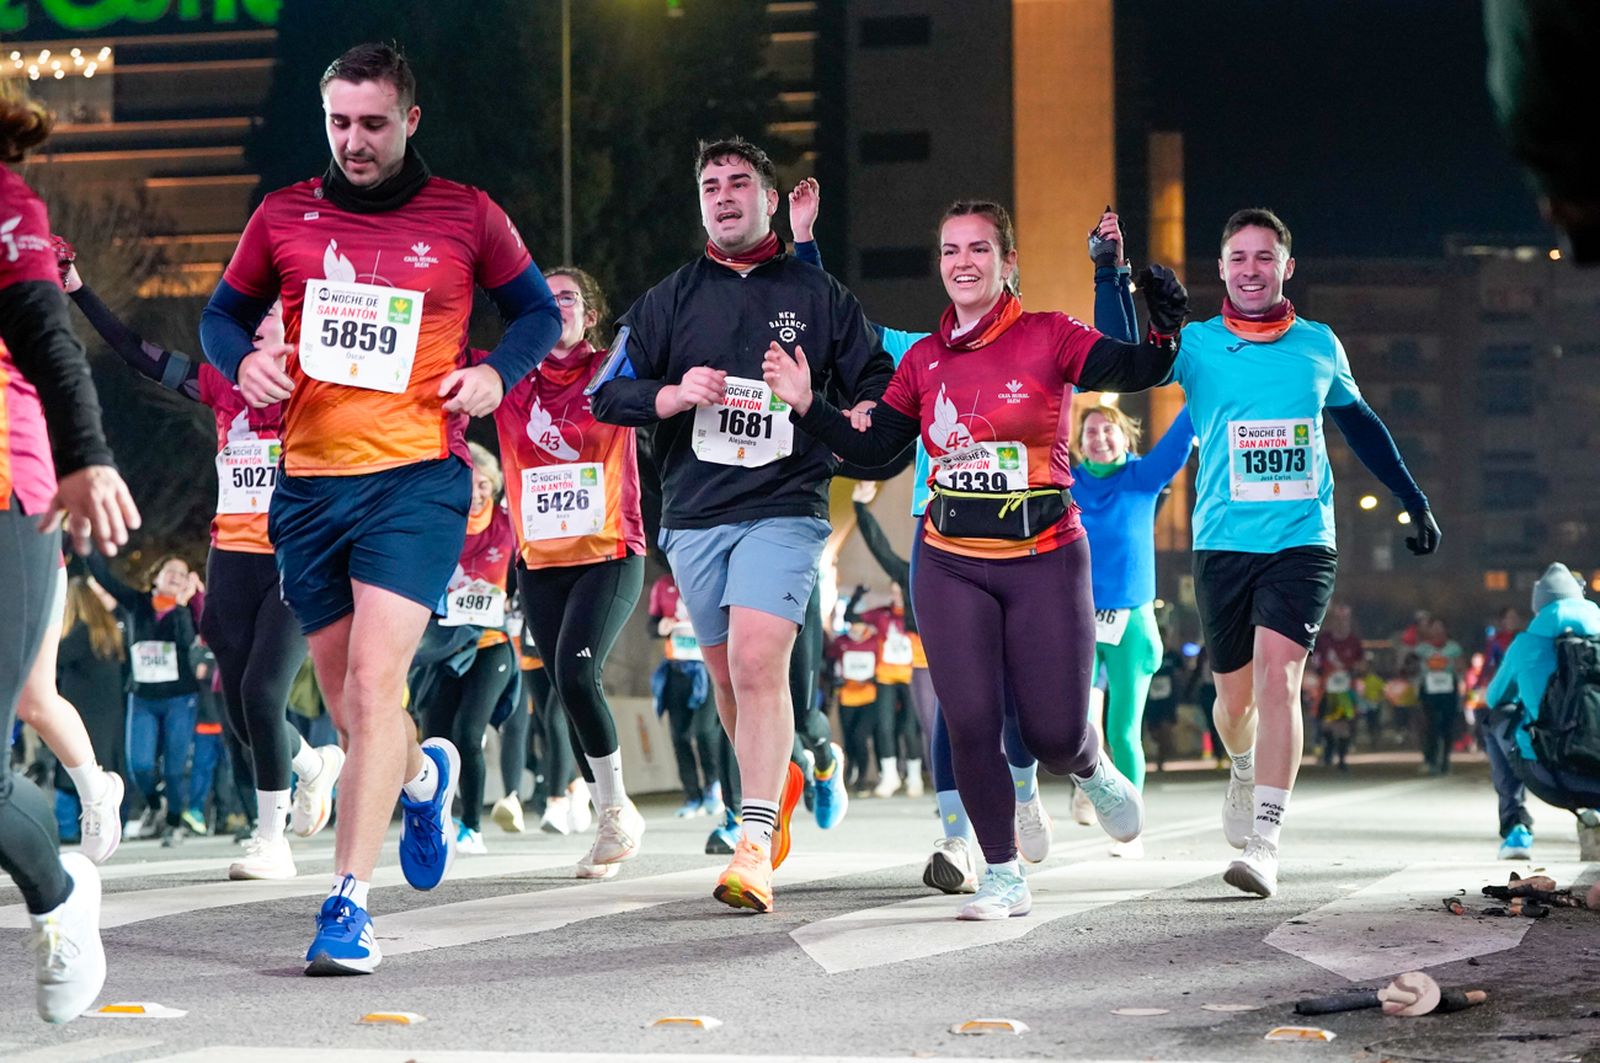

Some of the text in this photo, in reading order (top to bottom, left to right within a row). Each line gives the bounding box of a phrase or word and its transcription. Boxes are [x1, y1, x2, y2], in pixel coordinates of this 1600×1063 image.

[331, 294, 363, 306] NOCHE
[366, 297, 379, 308] DE
[317, 305, 339, 317] SAN
[778, 311, 796, 319] NEW
[769, 319, 807, 331] BALANCE
[321, 318, 397, 355] 5859
[751, 390, 764, 400] DE
[718, 408, 773, 440] 1681
[1248, 429, 1274, 438] NOCHE
[1276, 428, 1287, 437] DE
[539, 431, 560, 451] 43
[1239, 440, 1256, 448] SAN
[1242, 448, 1306, 474] 13973
[232, 466, 277, 488] 5027
[948, 471, 1008, 491] 1339
[531, 484, 546, 493] SAN
[536, 488, 590, 514] 5426
[455, 594, 493, 611] 4987
[1256, 815, 1282, 826] NEVE
